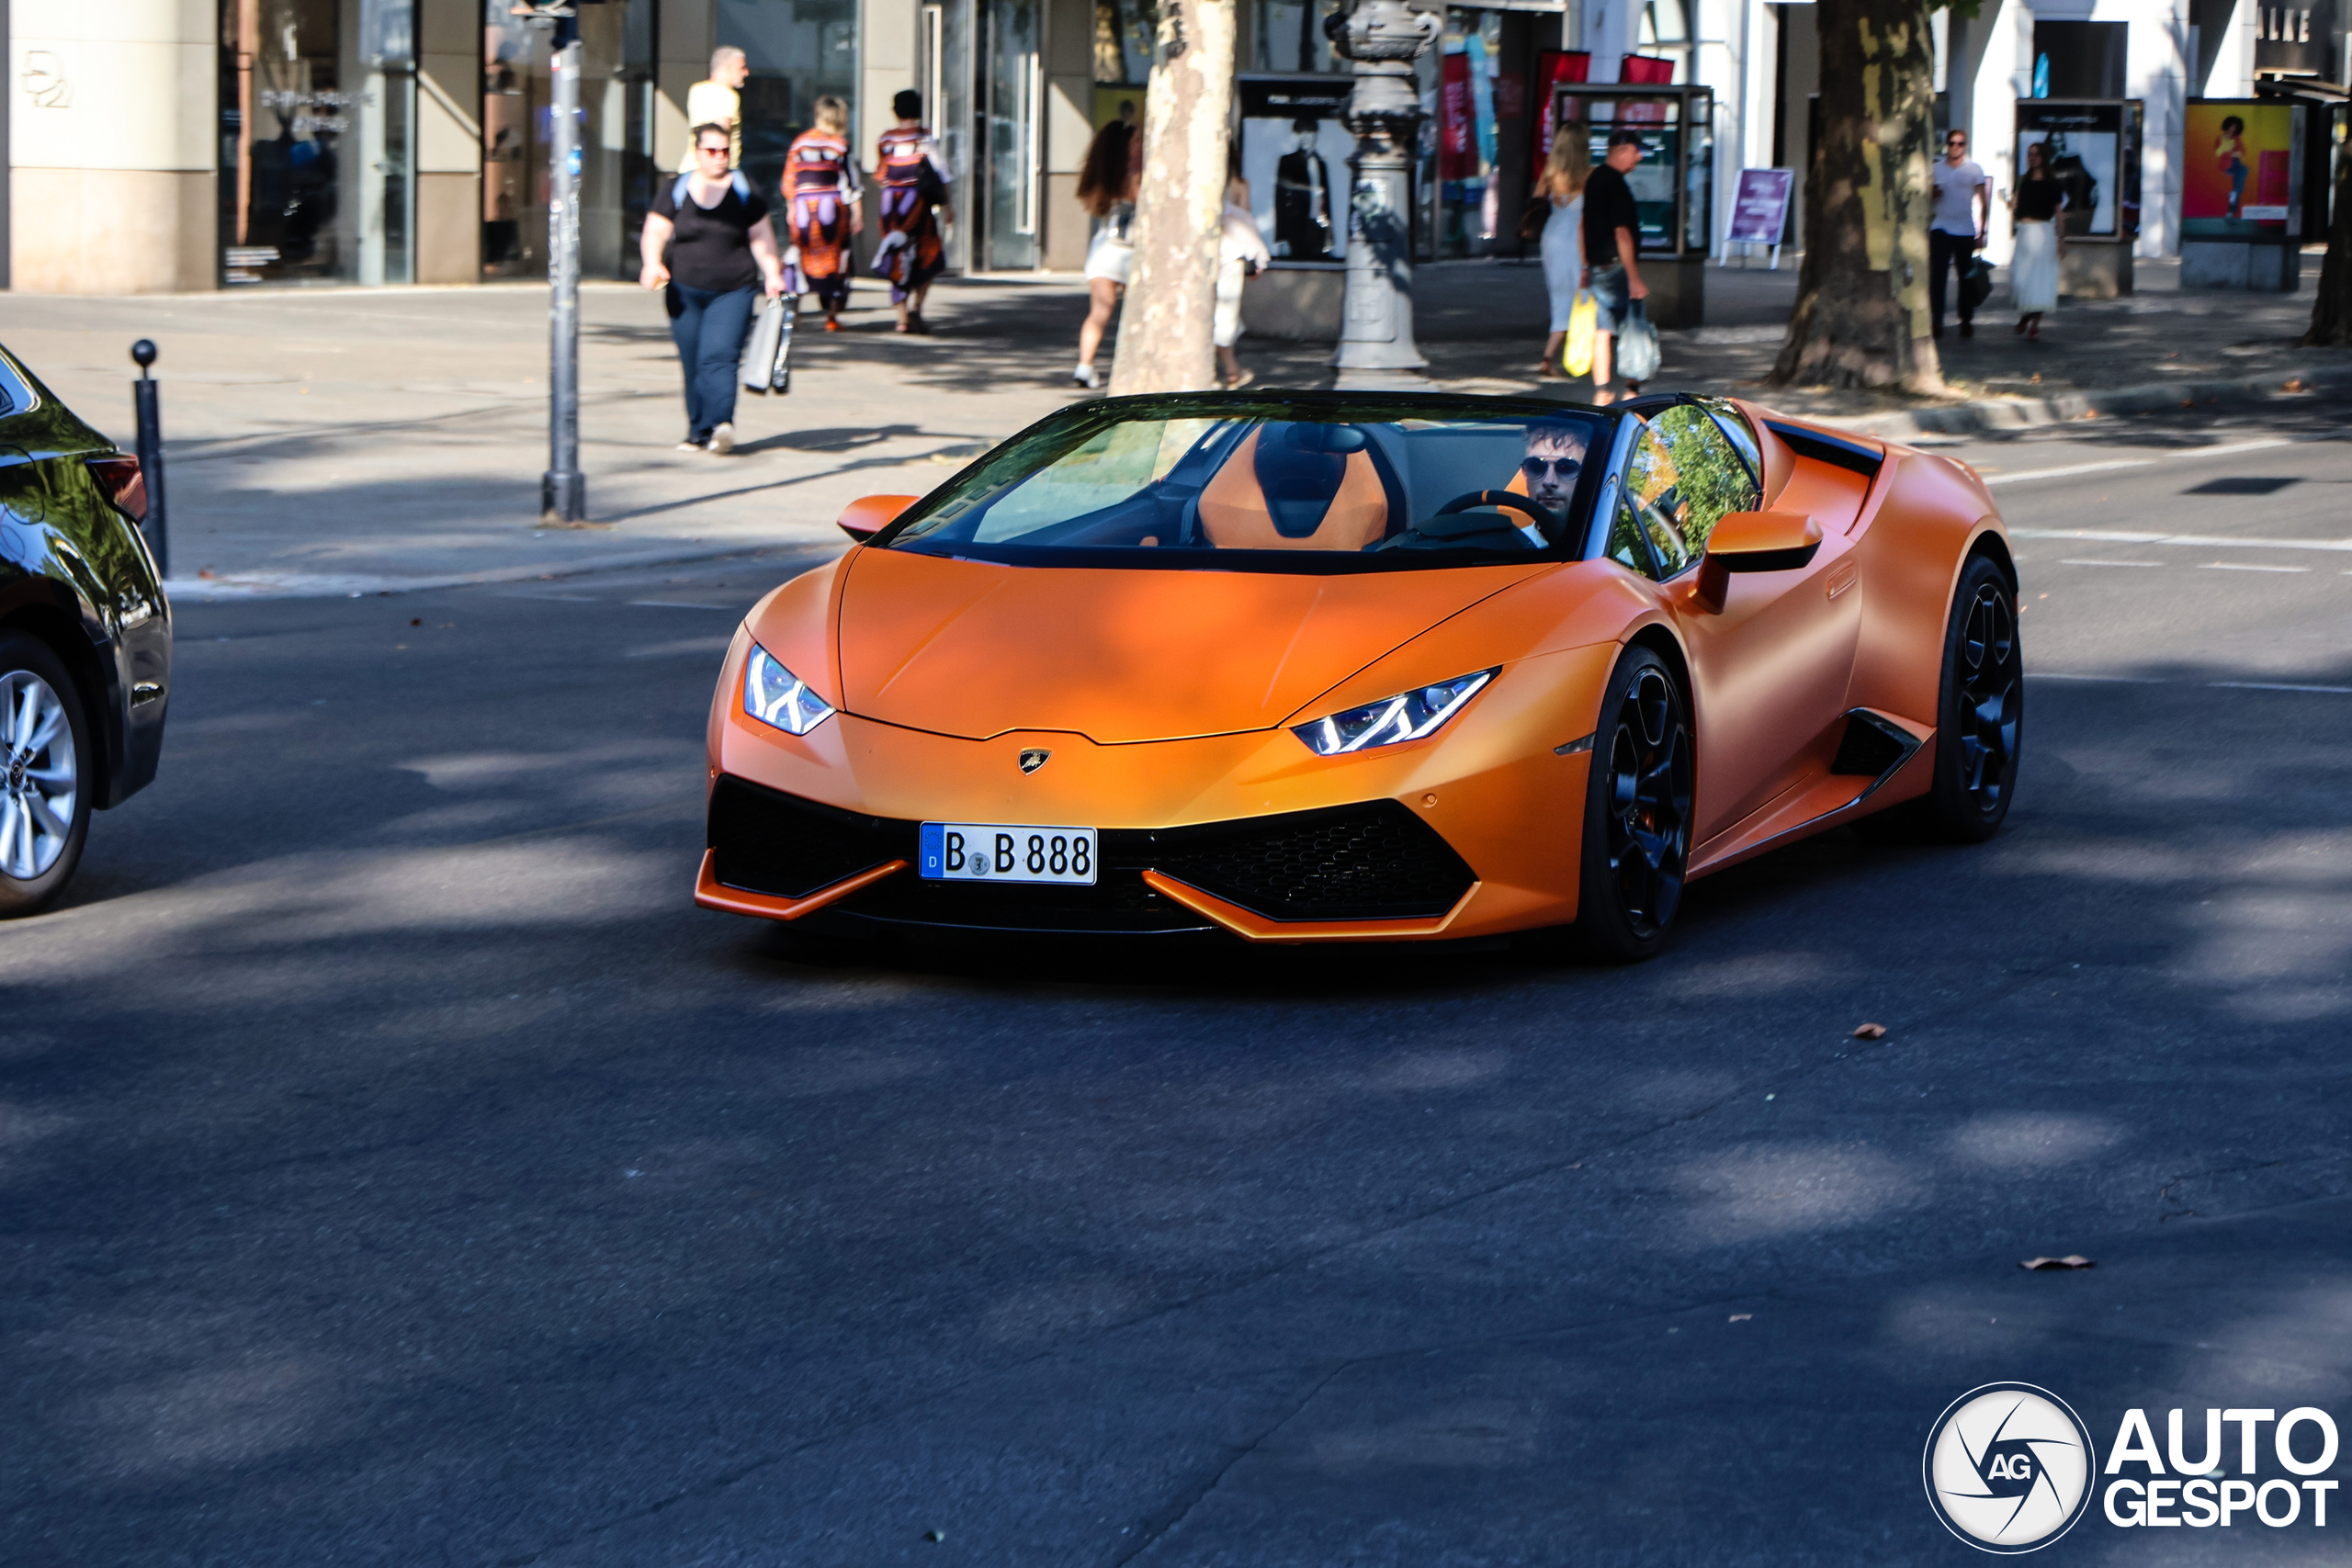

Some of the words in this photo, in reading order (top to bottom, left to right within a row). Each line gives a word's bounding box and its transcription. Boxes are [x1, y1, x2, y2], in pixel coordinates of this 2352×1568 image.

[929, 856, 937, 868] D
[945, 832, 966, 871] B
[995, 833, 1015, 873] B
[1026, 834, 1091, 875] 888
